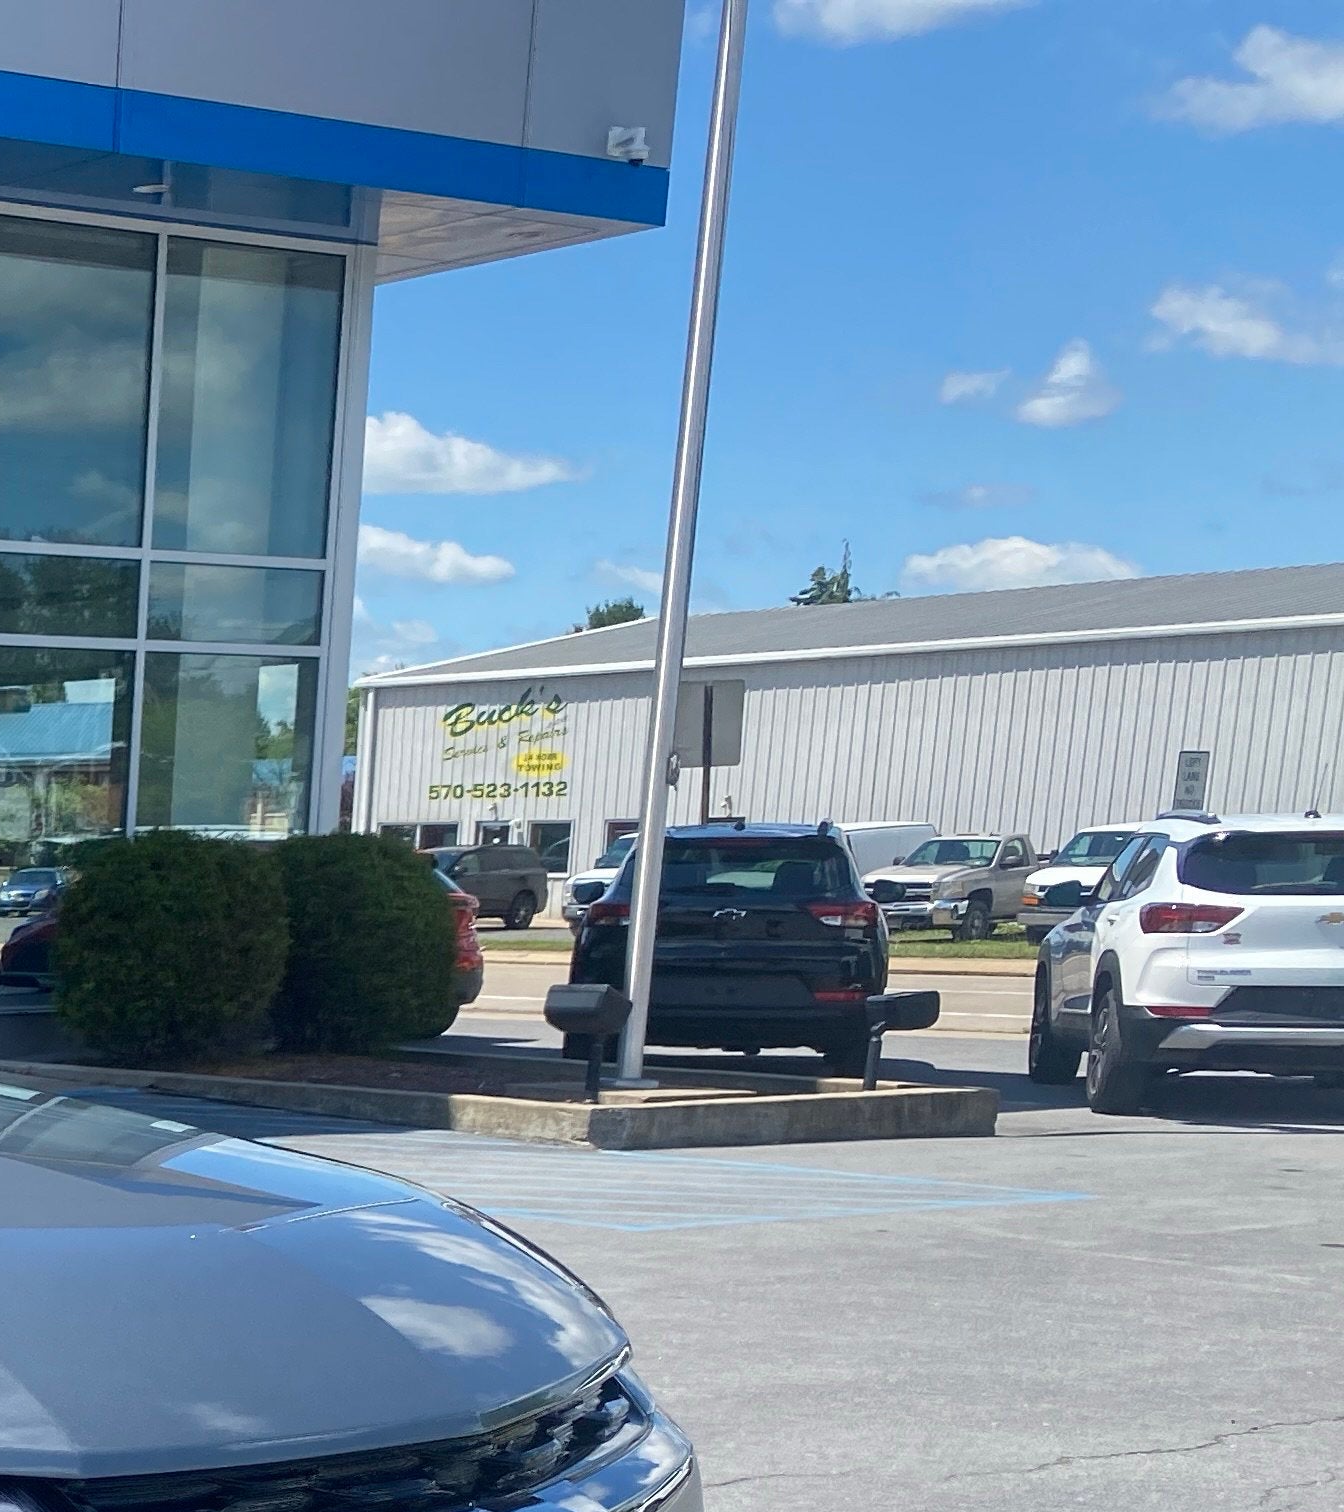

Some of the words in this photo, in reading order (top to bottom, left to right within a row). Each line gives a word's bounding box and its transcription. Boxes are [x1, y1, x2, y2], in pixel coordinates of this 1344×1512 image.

[442, 686, 568, 737] Buck's
[518, 763, 562, 772] TOWING
[428, 780, 568, 801] 570-523-1132
